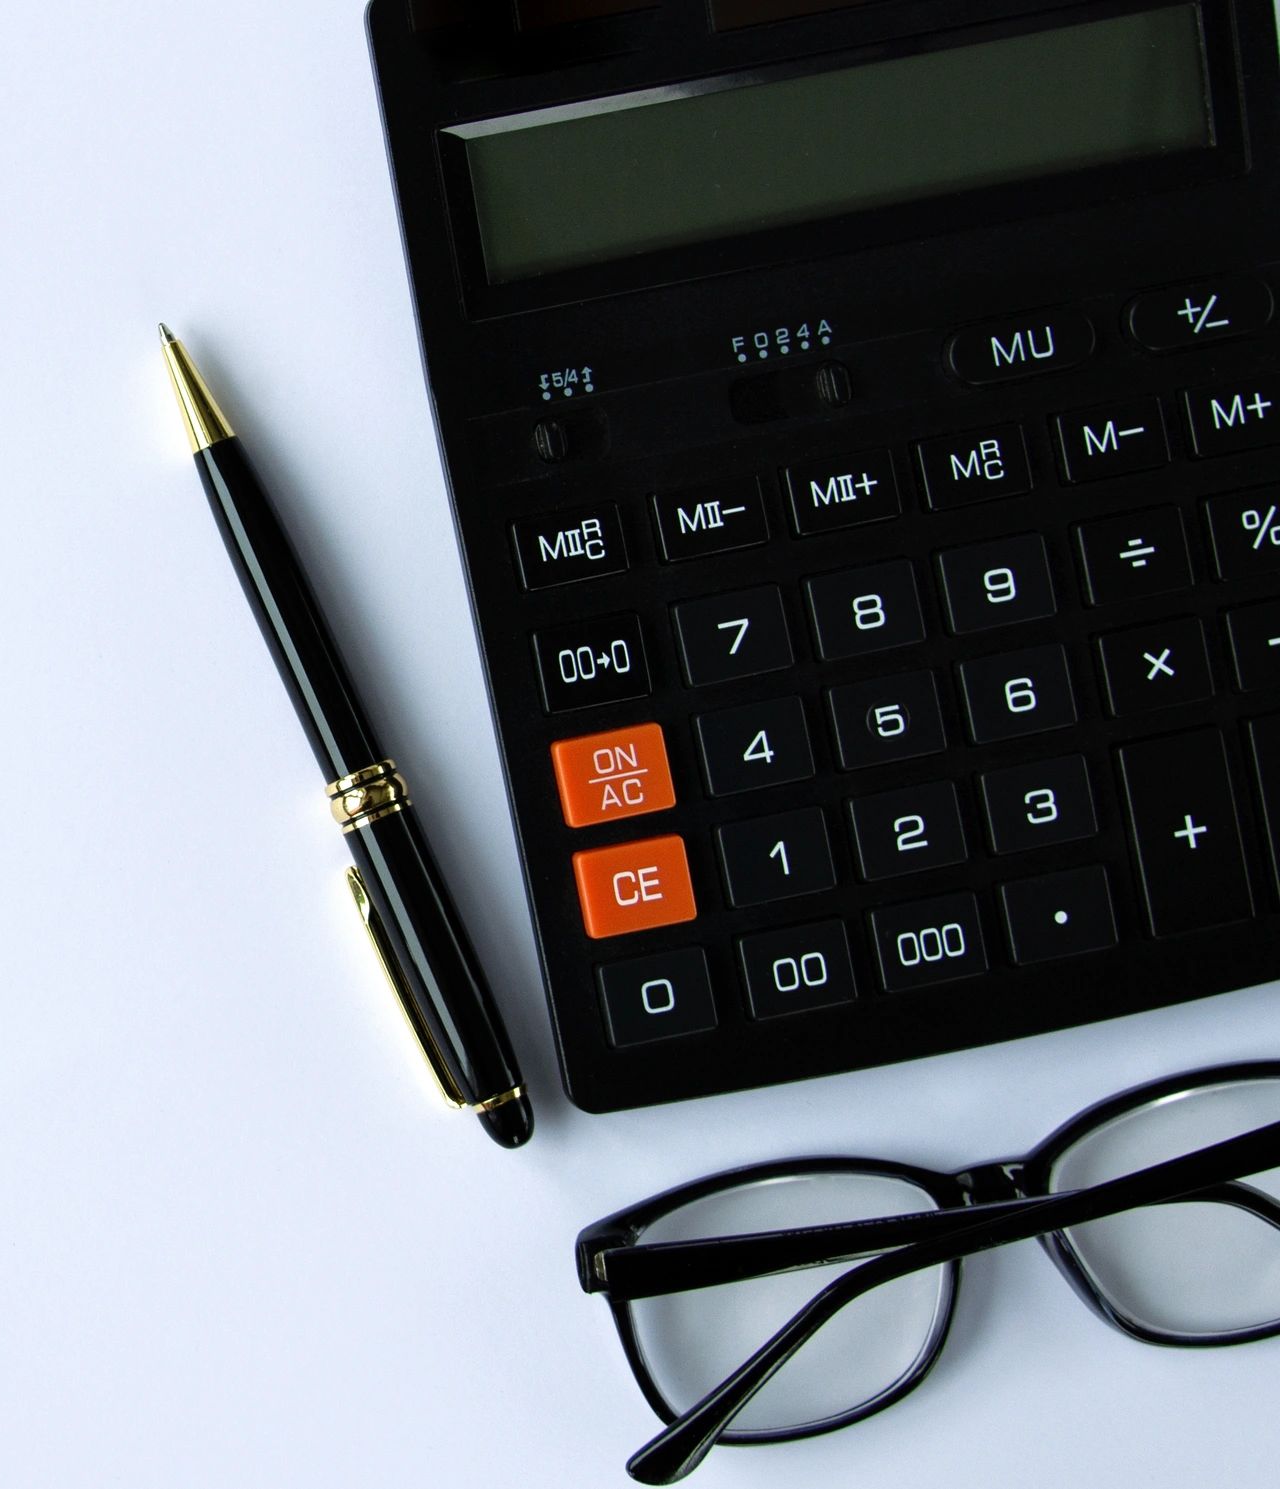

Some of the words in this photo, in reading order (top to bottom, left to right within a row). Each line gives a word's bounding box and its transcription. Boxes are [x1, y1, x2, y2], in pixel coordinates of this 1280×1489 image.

[732, 336, 745, 353] F
[775, 328, 790, 344] 2
[796, 324, 810, 339] 4
[817, 319, 832, 335] A
[990, 326, 1054, 367] MU
[1210, 392, 1272, 429] M+
[1241, 505, 1280, 550] %
[983, 567, 1017, 603] 9
[852, 594, 886, 630] 8
[717, 618, 749, 655] 7
[1004, 677, 1037, 713] 6
[874, 704, 906, 737] 5
[592, 743, 639, 775] ON
[743, 730, 775, 764] 4
[600, 778, 645, 811] AC
[1024, 788, 1058, 824] 3
[893, 814, 929, 851] 2
[769, 840, 791, 876] 1
[612, 866, 664, 907] CE
[897, 923, 966, 966] 000
[772, 951, 828, 992] 00
[641, 978, 675, 1014] 0
